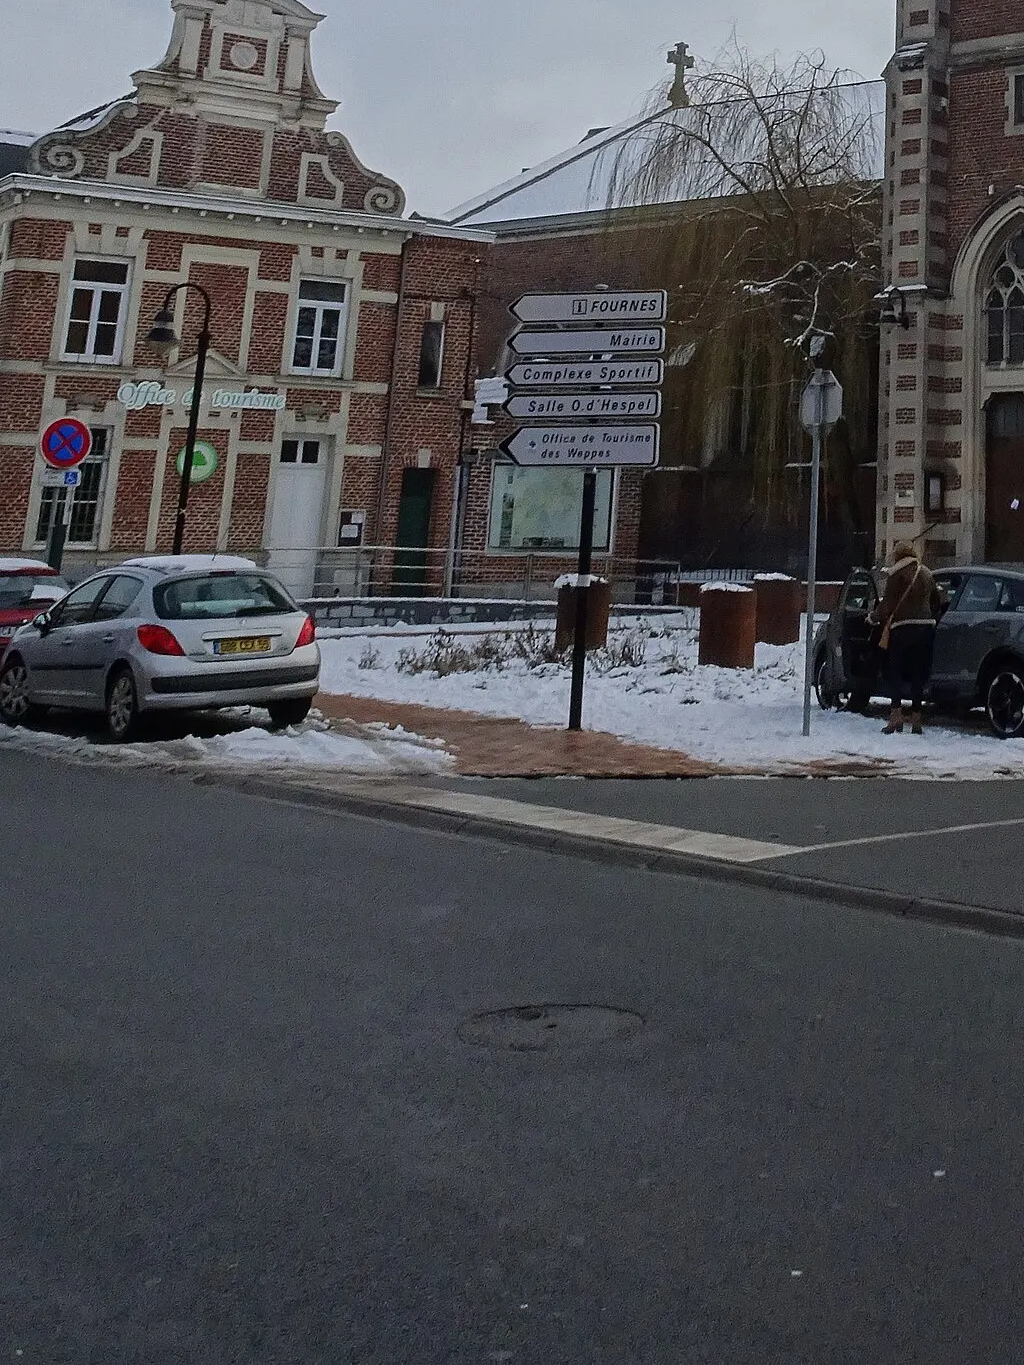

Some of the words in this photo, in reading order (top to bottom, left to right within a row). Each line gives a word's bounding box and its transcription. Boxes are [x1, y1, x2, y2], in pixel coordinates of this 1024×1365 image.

[590, 299, 657, 313] FOURNES
[610, 334, 656, 347] Mairie
[523, 368, 592, 382] Complexe
[599, 366, 654, 381] Sportif
[118, 382, 175, 409] Office
[213, 388, 286, 409] tourisme
[528, 400, 564, 413] Salle
[542, 433, 575, 443] Office
[582, 433, 595, 443] de
[602, 432, 651, 443] Tourisme
[540, 448, 560, 459] des
[567, 448, 611, 461] Weppes
